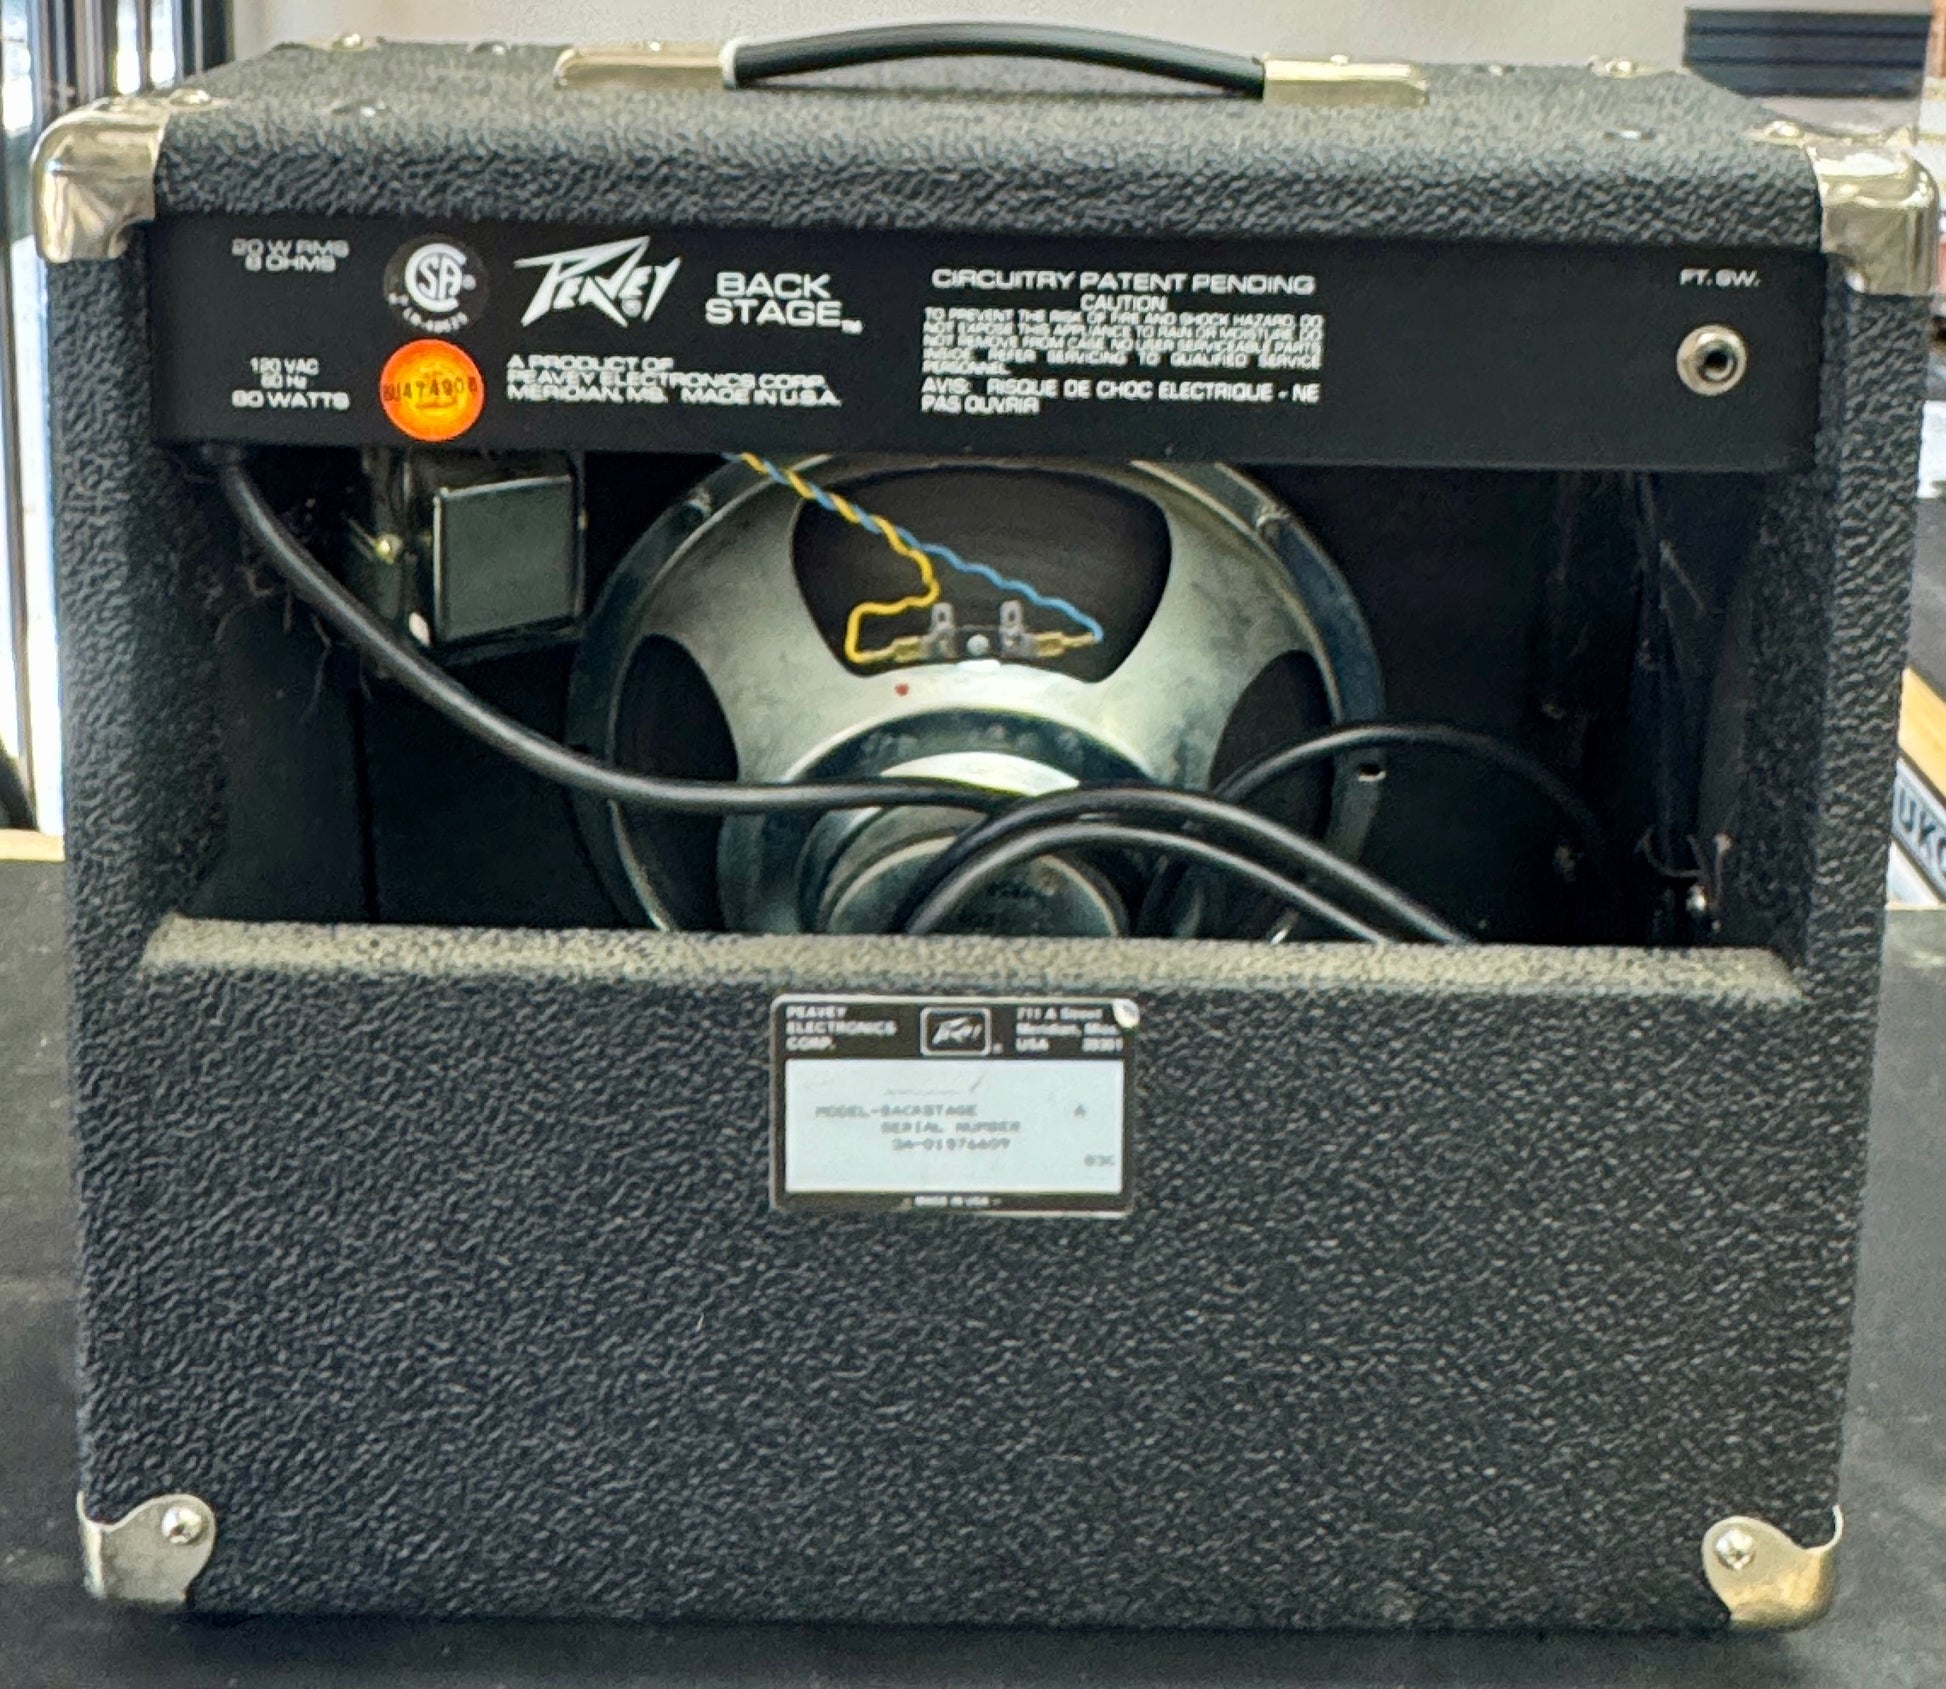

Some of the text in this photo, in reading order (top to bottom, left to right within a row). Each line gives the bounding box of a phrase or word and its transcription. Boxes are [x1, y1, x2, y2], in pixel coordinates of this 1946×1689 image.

[266, 239, 293, 257] W
[265, 255, 337, 272] OHMS
[716, 271, 832, 300] BACK
[931, 268, 1316, 296] CIRCUITRY PATENT PENDING
[705, 298, 842, 328] STAGE
[1080, 293, 1168, 313] CAUTION
[507, 354, 675, 373] A PRODUCT OF
[507, 368, 597, 386] PEAVEY
[599, 371, 757, 390] ELECTRONICS
[266, 391, 351, 411] WATTS
[679, 388, 750, 406] MADE
[752, 388, 779, 407] IN
[986, 378, 1060, 398] RISQUE
[1063, 379, 1092, 399] DE
[1095, 380, 1155, 401] CHOC
[1158, 381, 1274, 402] ELECTRIQUE
[1292, 383, 1322, 405] NE
[921, 394, 1040, 416] PAS OUVRIR
[881, 1121, 1021, 1134] SERIAL NUMBER
